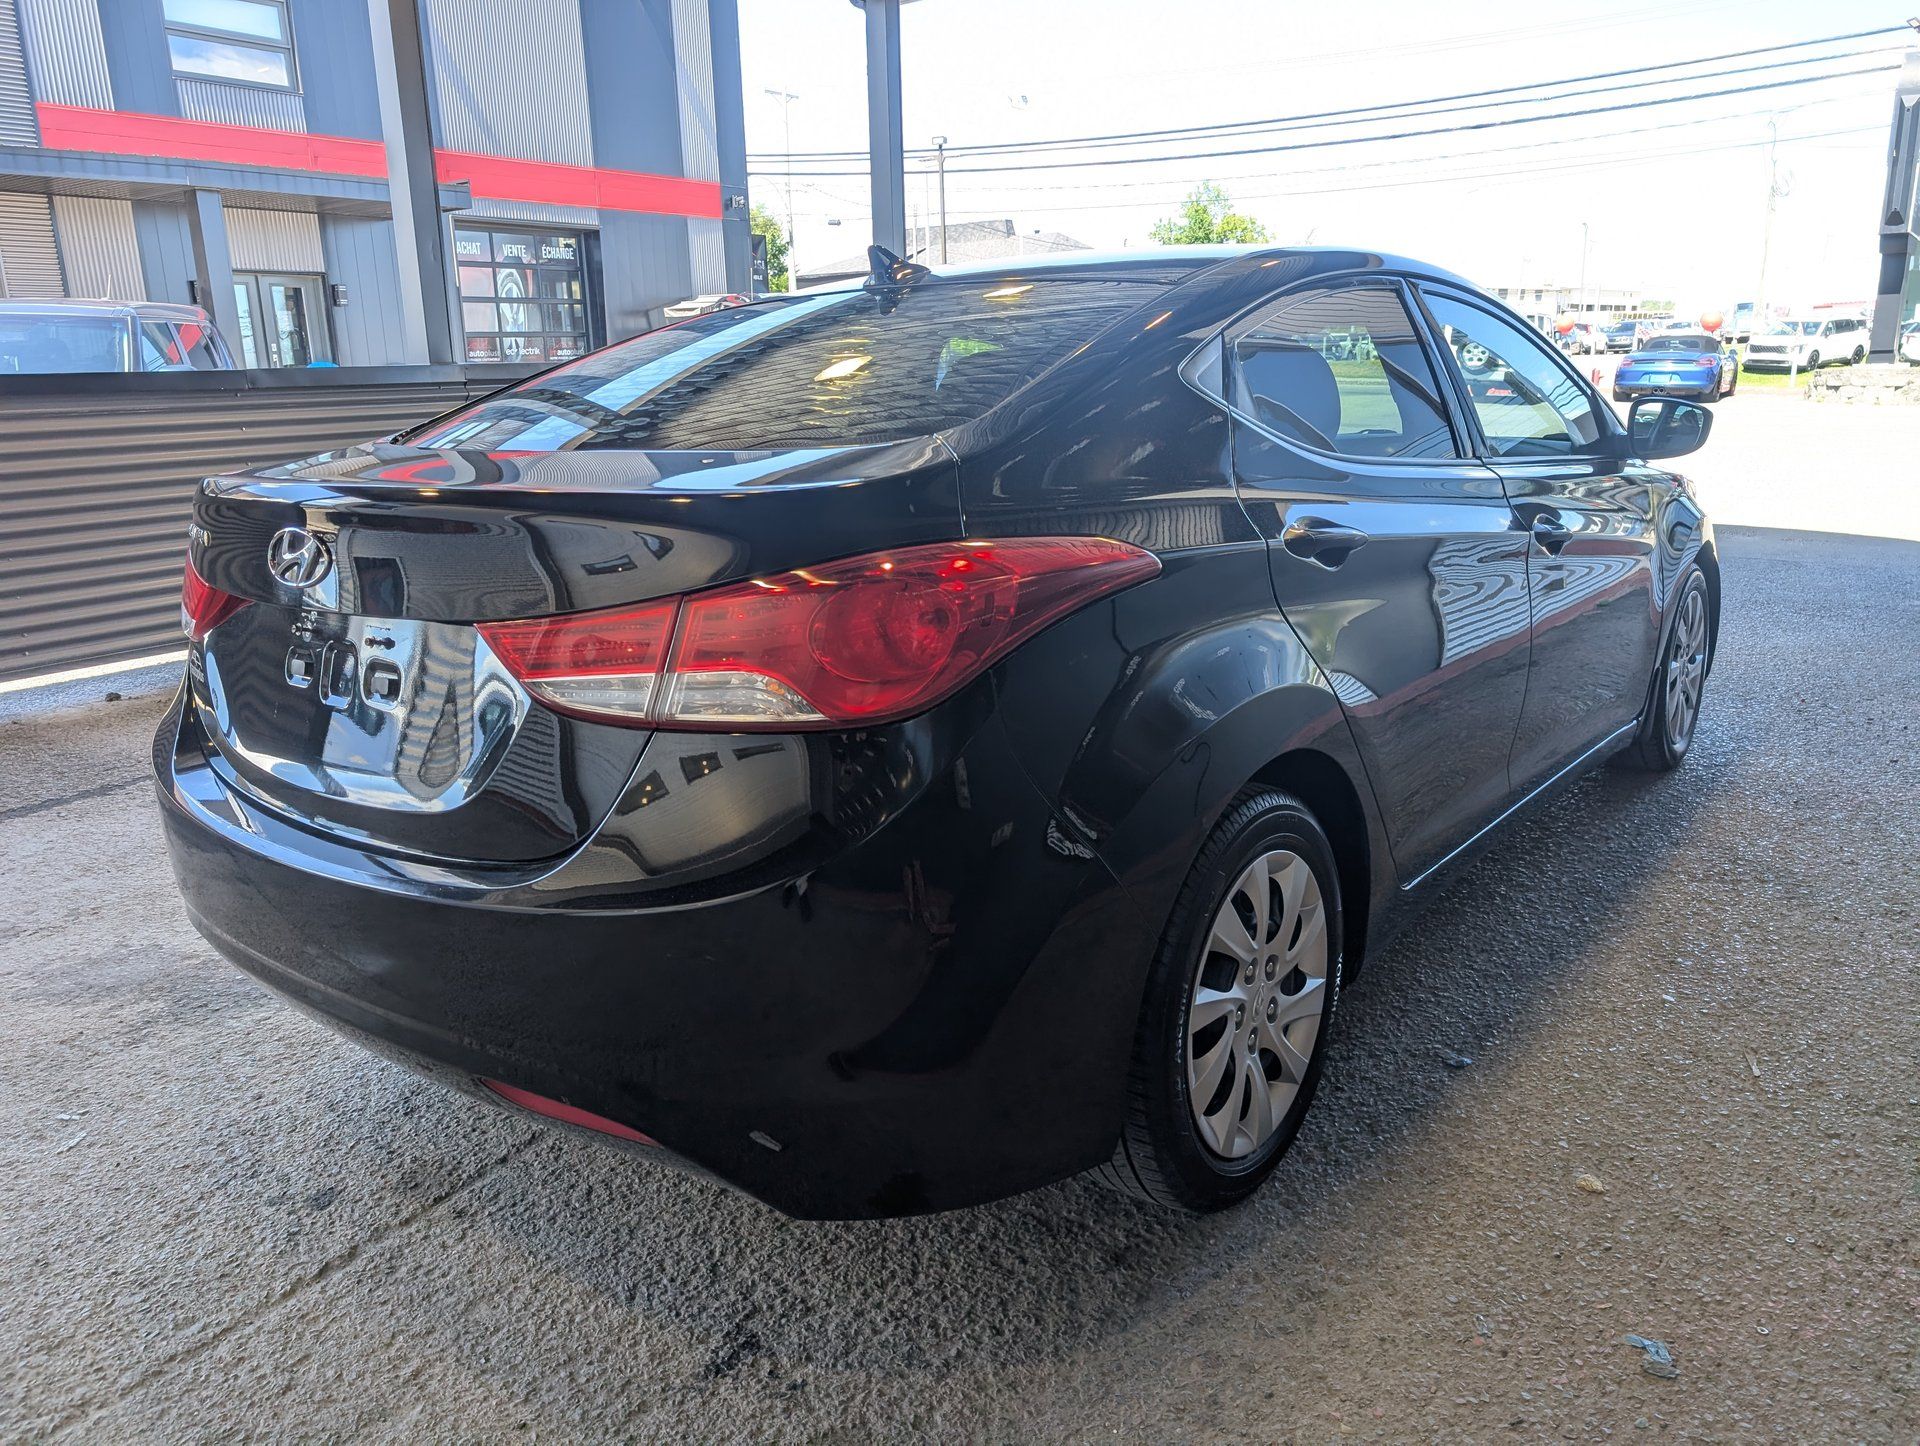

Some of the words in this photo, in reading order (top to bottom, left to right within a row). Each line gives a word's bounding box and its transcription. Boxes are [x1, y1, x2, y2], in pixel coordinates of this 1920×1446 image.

[456, 241, 481, 255] ACHAT
[502, 244, 527, 258] VENTE
[541, 244, 574, 260] ÉCHANGE
[1327, 952, 1343, 1035] YOKOHA
